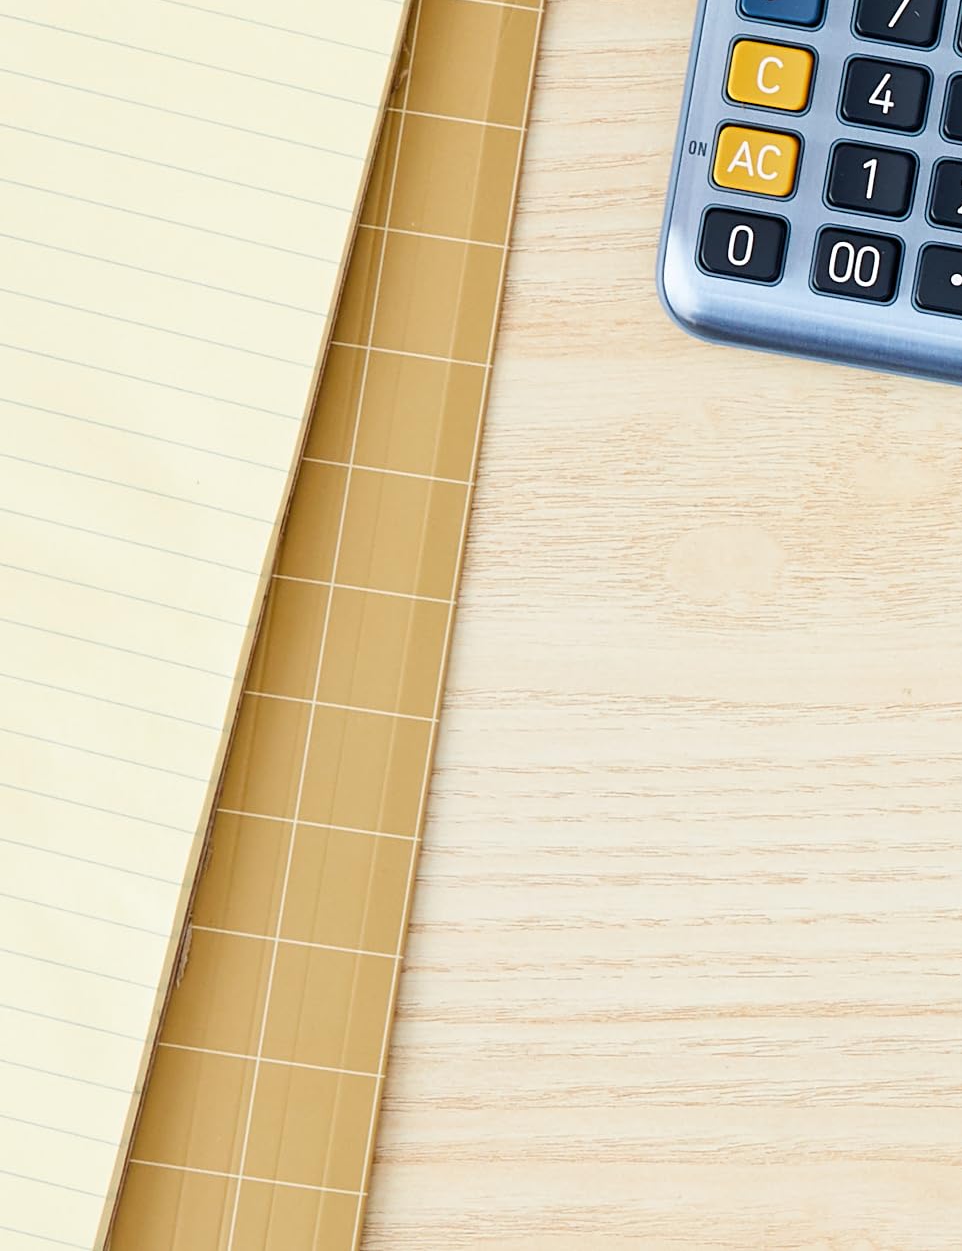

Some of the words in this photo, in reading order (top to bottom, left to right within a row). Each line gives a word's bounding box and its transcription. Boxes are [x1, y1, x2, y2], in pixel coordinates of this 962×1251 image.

[756, 56, 784, 94] C
[868, 73, 895, 114] 4
[688, 140, 708, 157] ON
[727, 141, 781, 181] AC
[863, 158, 878, 199] 1
[727, 224, 754, 266] 0
[828, 241, 880, 287] 00
